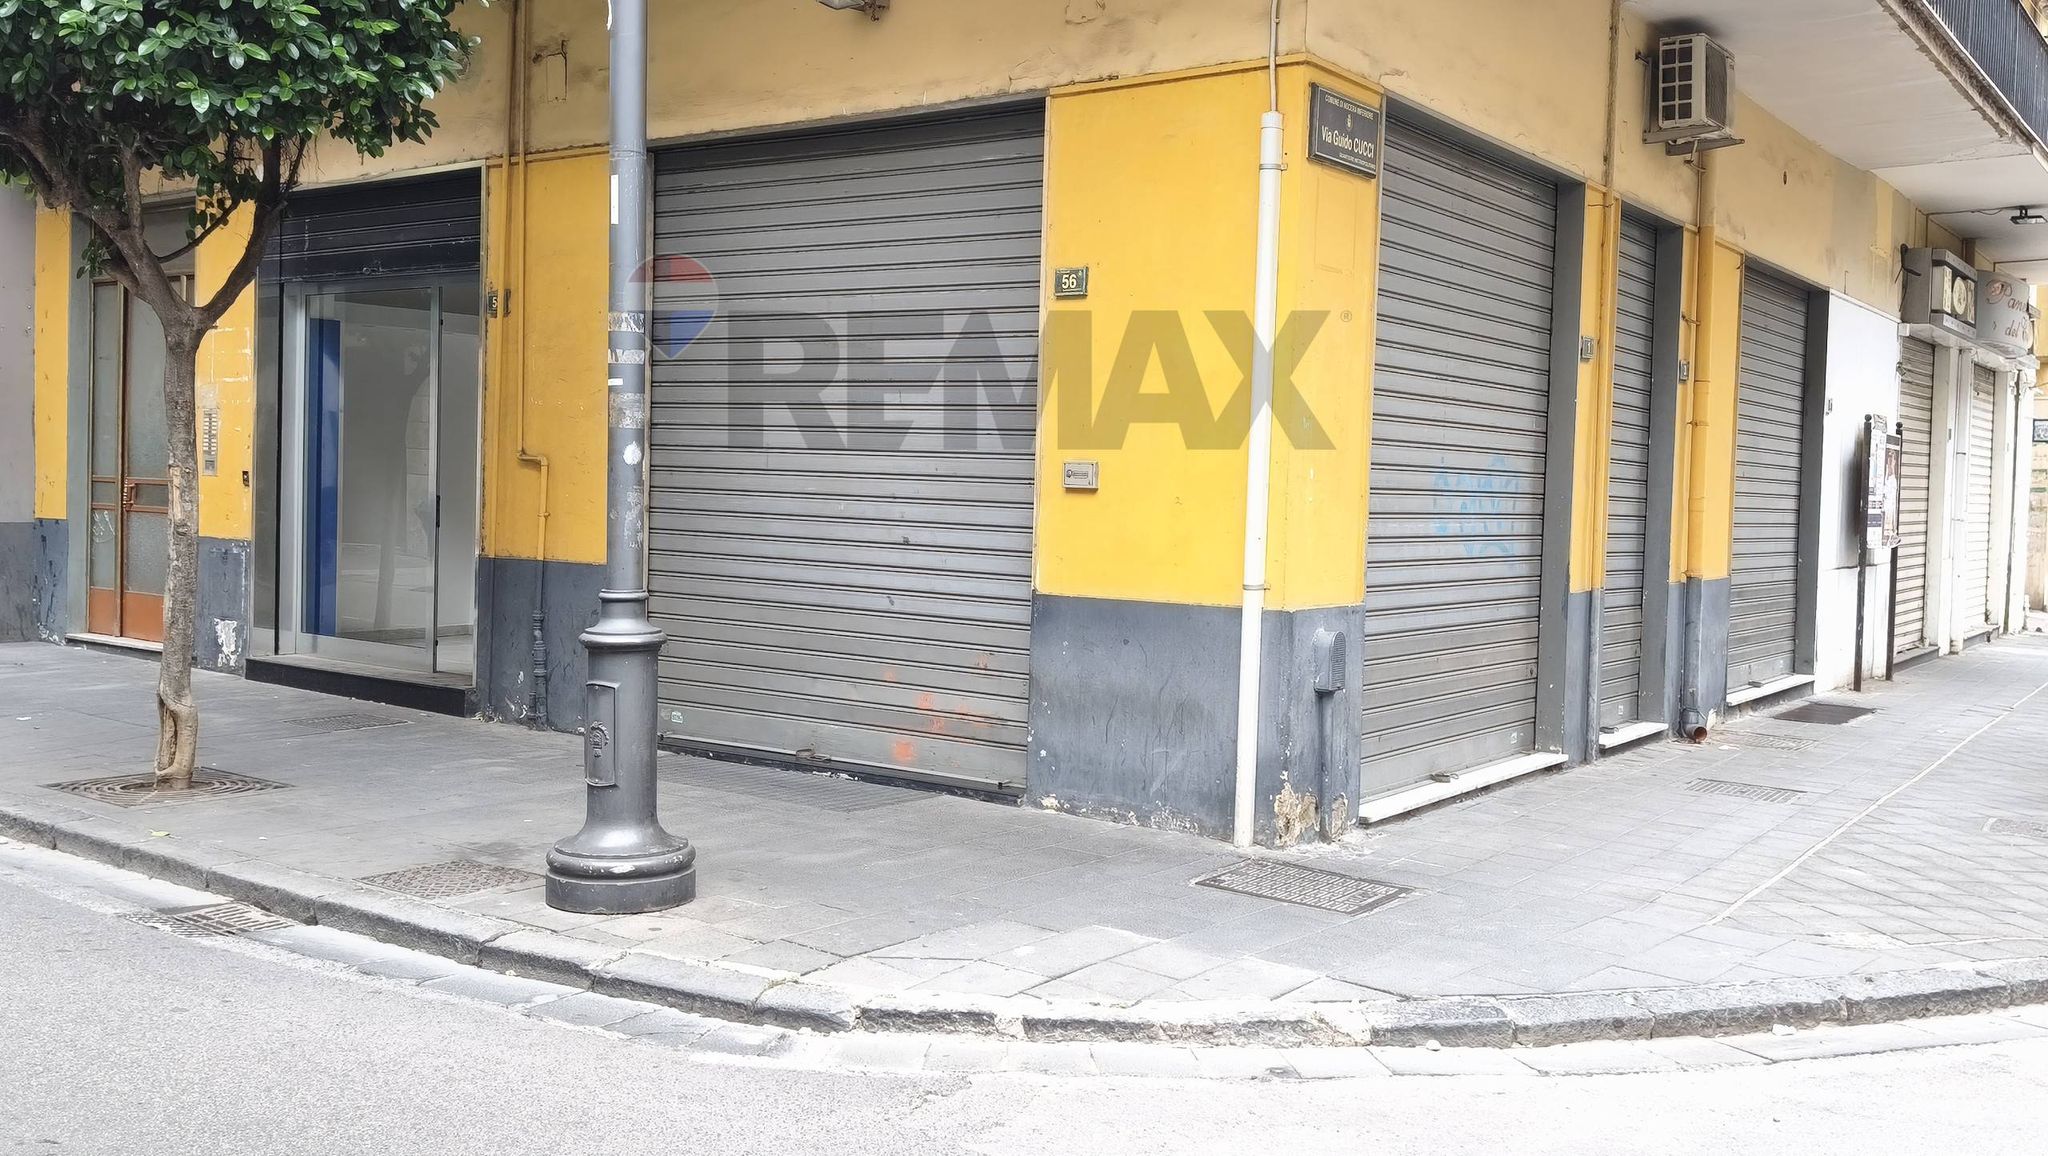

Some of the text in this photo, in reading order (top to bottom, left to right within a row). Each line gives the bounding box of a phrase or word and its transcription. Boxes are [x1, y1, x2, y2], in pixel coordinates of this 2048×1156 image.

[1321, 125, 1375, 158] Via Guido CUCCI
[1061, 273, 1077, 289] 56
